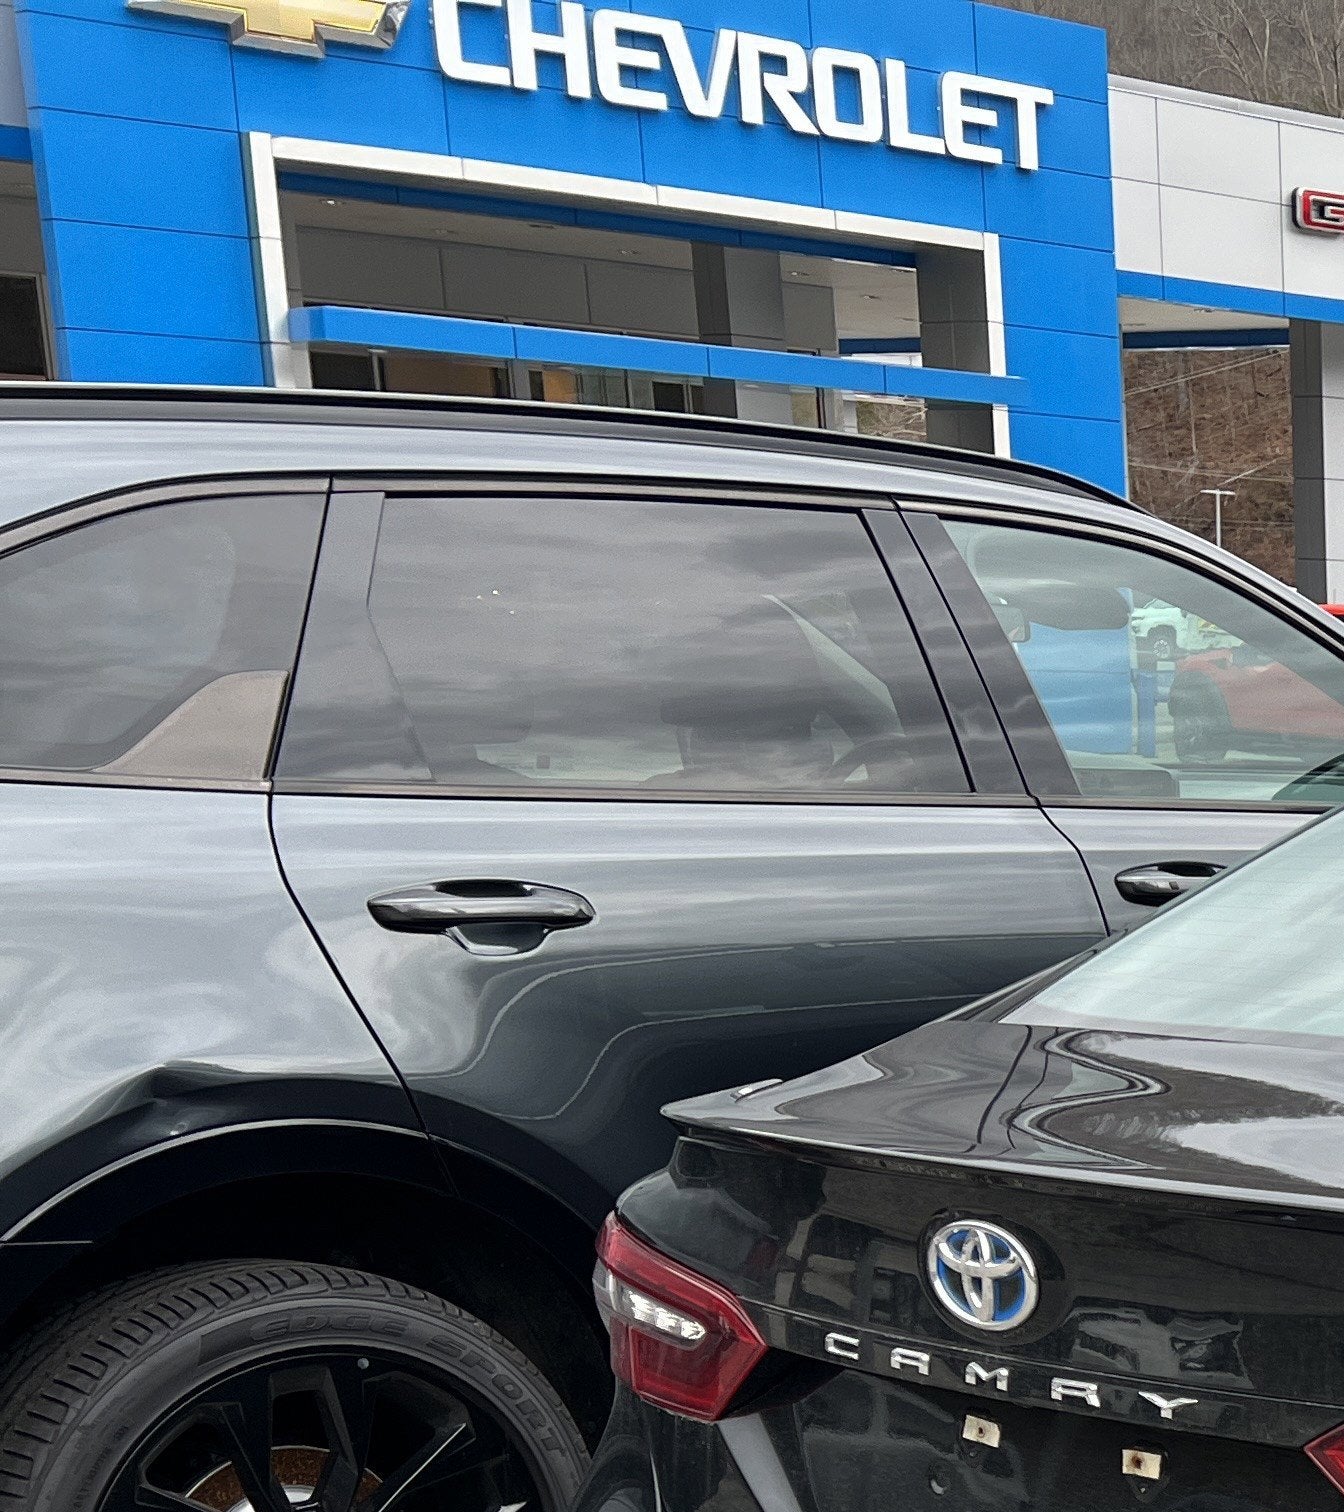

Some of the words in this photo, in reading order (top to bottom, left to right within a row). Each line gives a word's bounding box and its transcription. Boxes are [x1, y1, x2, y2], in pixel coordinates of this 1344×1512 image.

[433, 0, 1054, 171] CHEVROLET
[250, 1311, 410, 1343] EDGE
[424, 1332, 570, 1458] SPORT
[825, 1332, 1199, 1420] CAMRY
